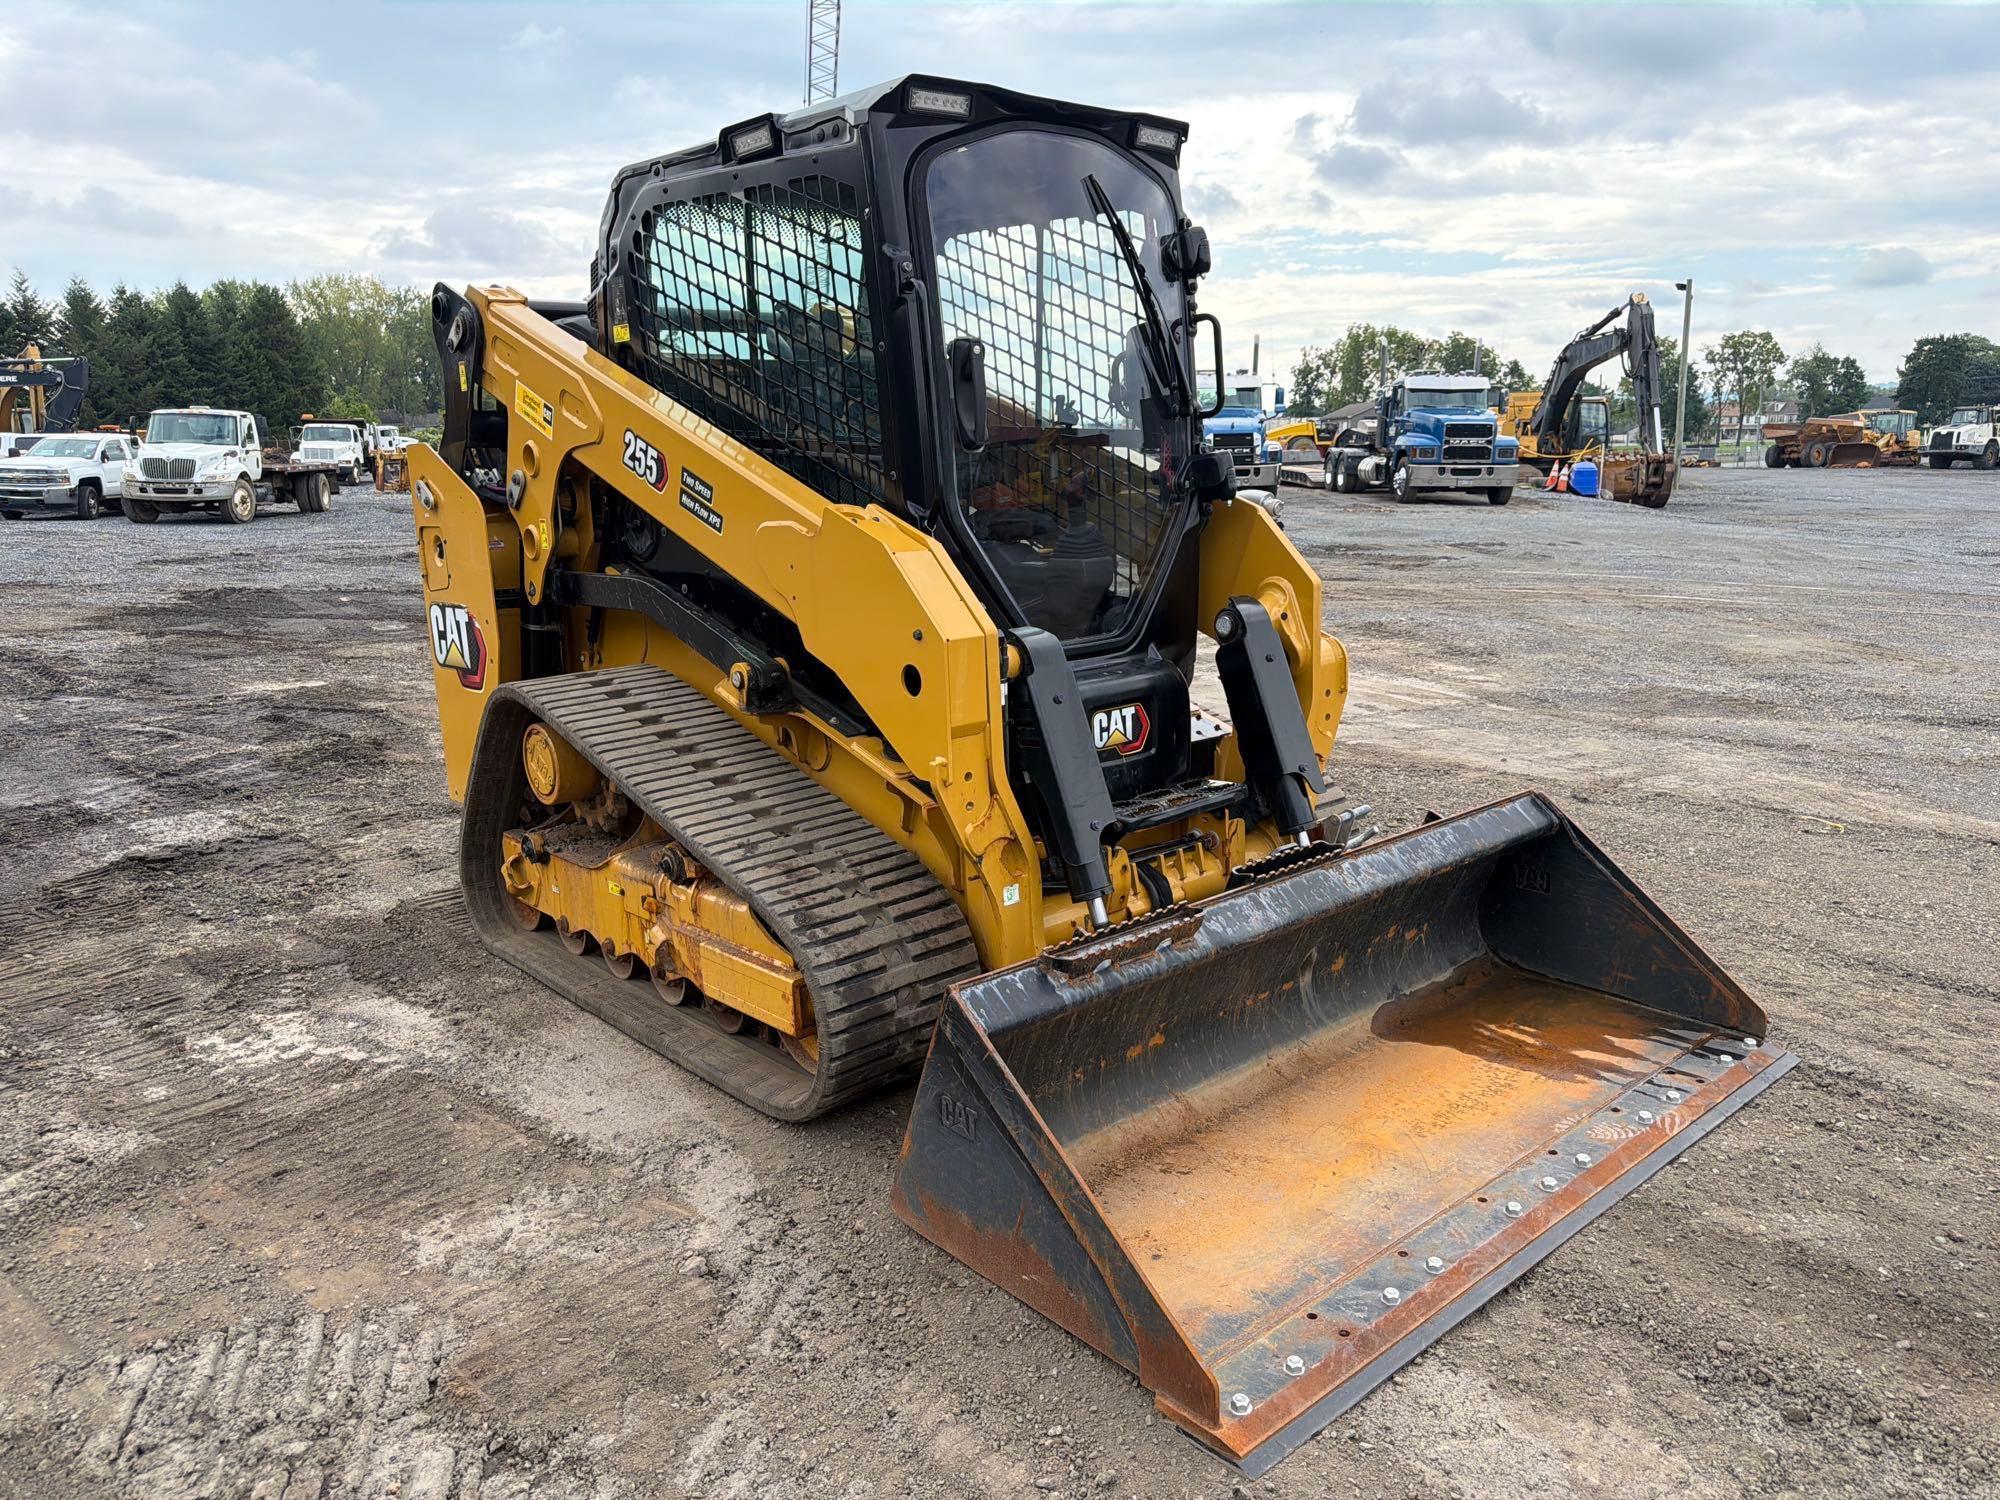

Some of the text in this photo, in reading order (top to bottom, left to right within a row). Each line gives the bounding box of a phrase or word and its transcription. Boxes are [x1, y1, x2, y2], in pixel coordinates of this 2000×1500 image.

[624, 430, 657, 484] 255
[709, 512, 721, 528] XPS
[430, 604, 471, 669] CAT
[1093, 706, 1136, 748] CAT
[941, 1094, 978, 1141] CAT
